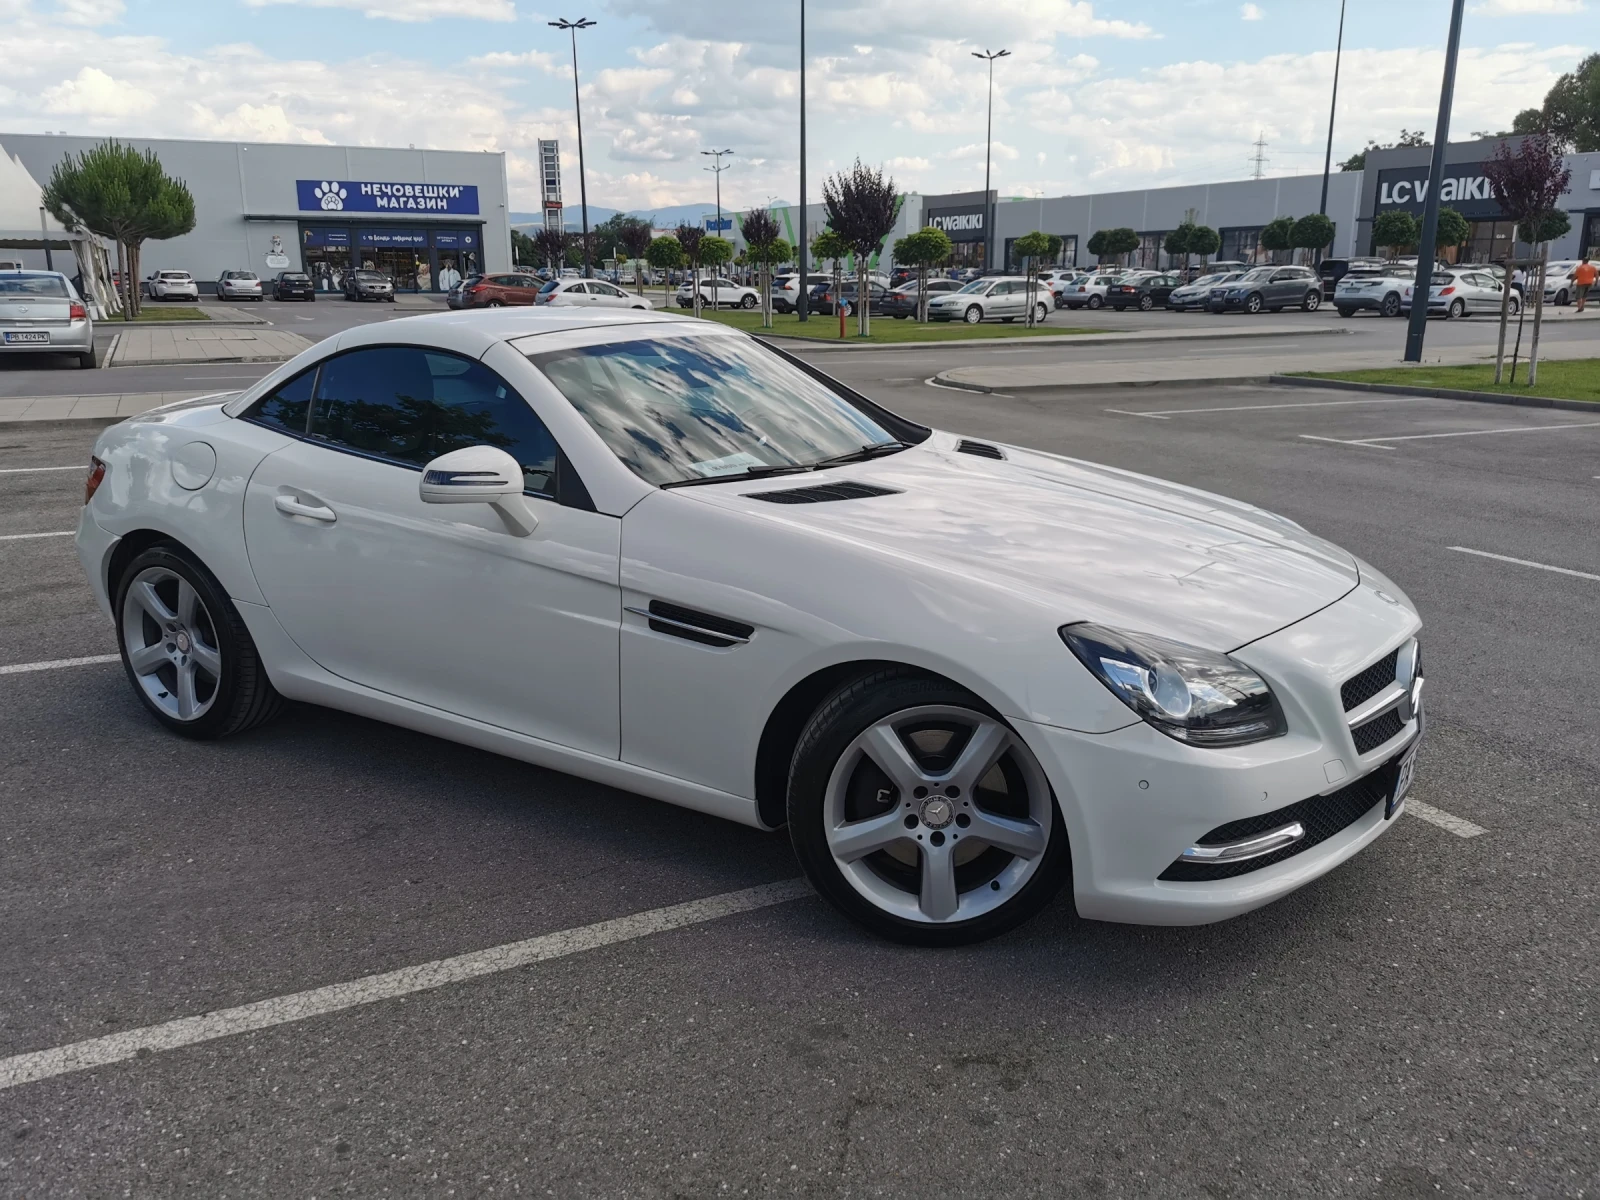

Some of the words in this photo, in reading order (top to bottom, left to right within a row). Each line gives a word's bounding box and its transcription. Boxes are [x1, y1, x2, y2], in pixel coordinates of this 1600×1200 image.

[361, 183, 460, 199] НЕЧОВЕШКИ
[1380, 181, 1412, 204] LC
[376, 197, 448, 210] МАГАЗИН
